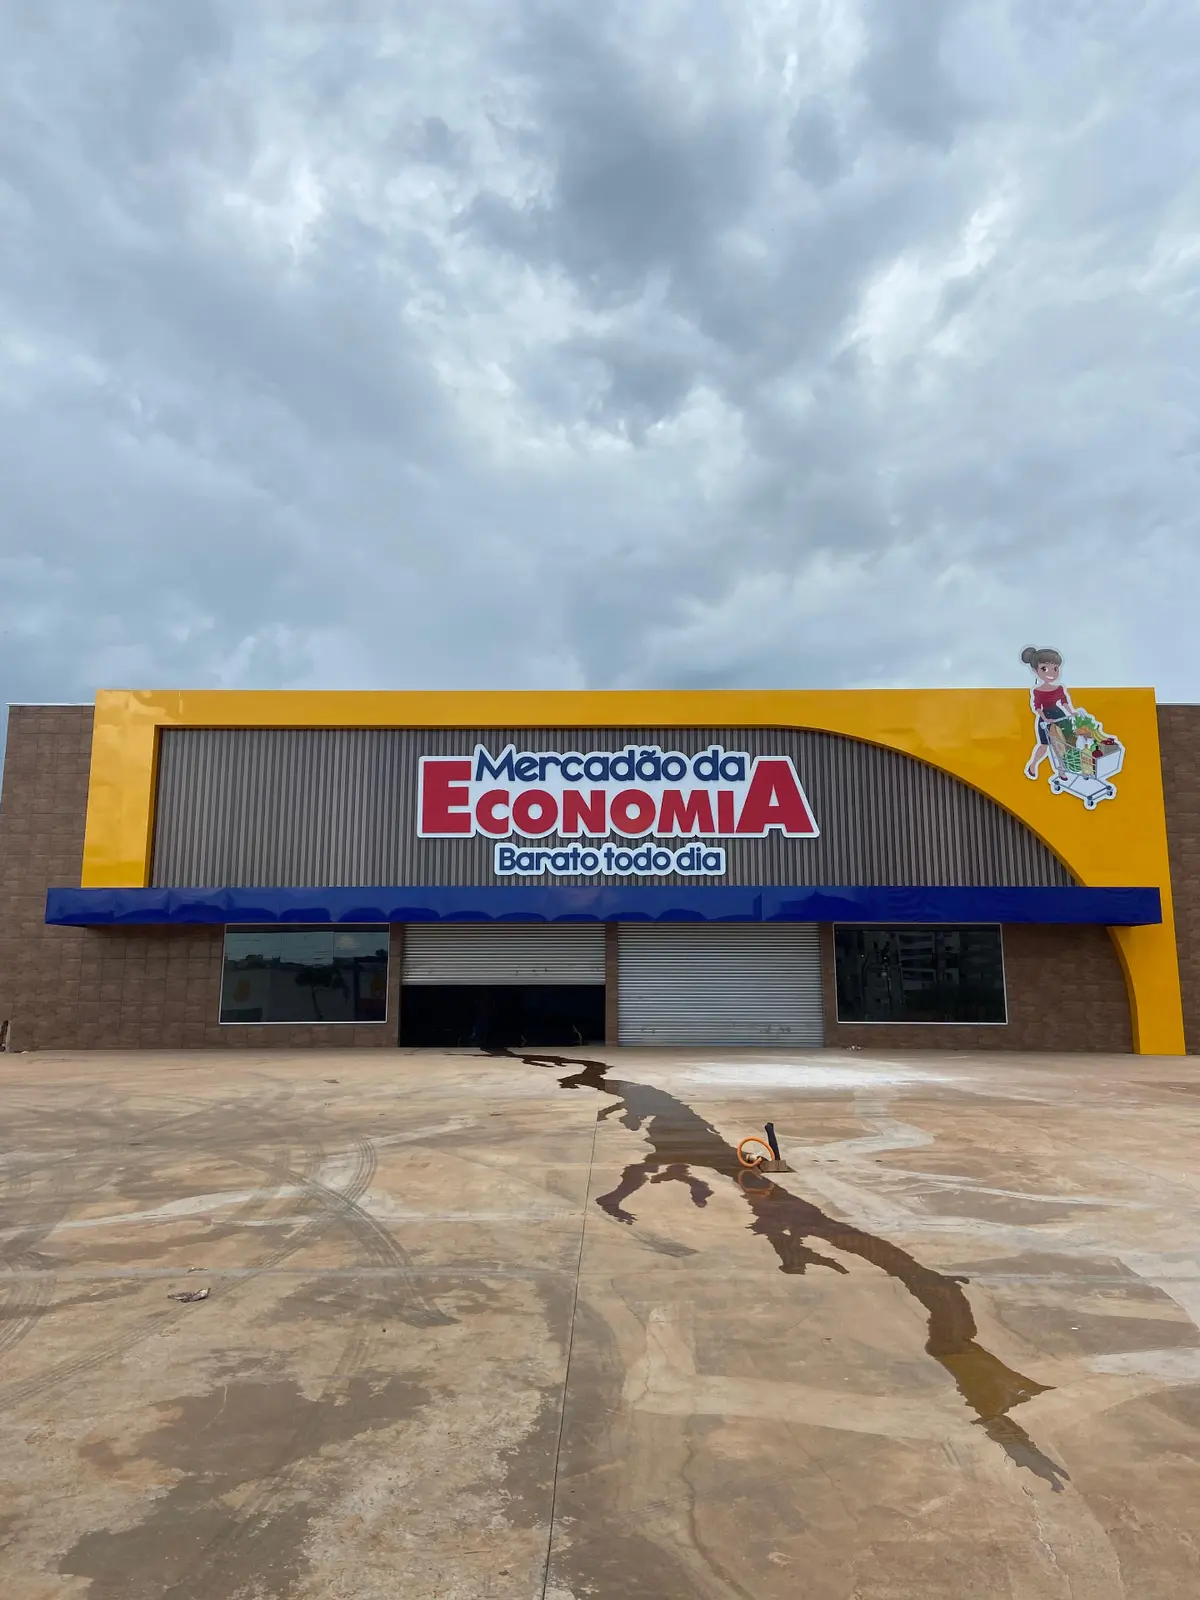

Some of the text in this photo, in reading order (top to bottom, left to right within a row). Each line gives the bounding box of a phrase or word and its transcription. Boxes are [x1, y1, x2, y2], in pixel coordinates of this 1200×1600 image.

[475, 749, 746, 782] Mercadão da
[422, 760, 815, 834] ECONOMIA
[498, 847, 721, 871] Barato todo dia
